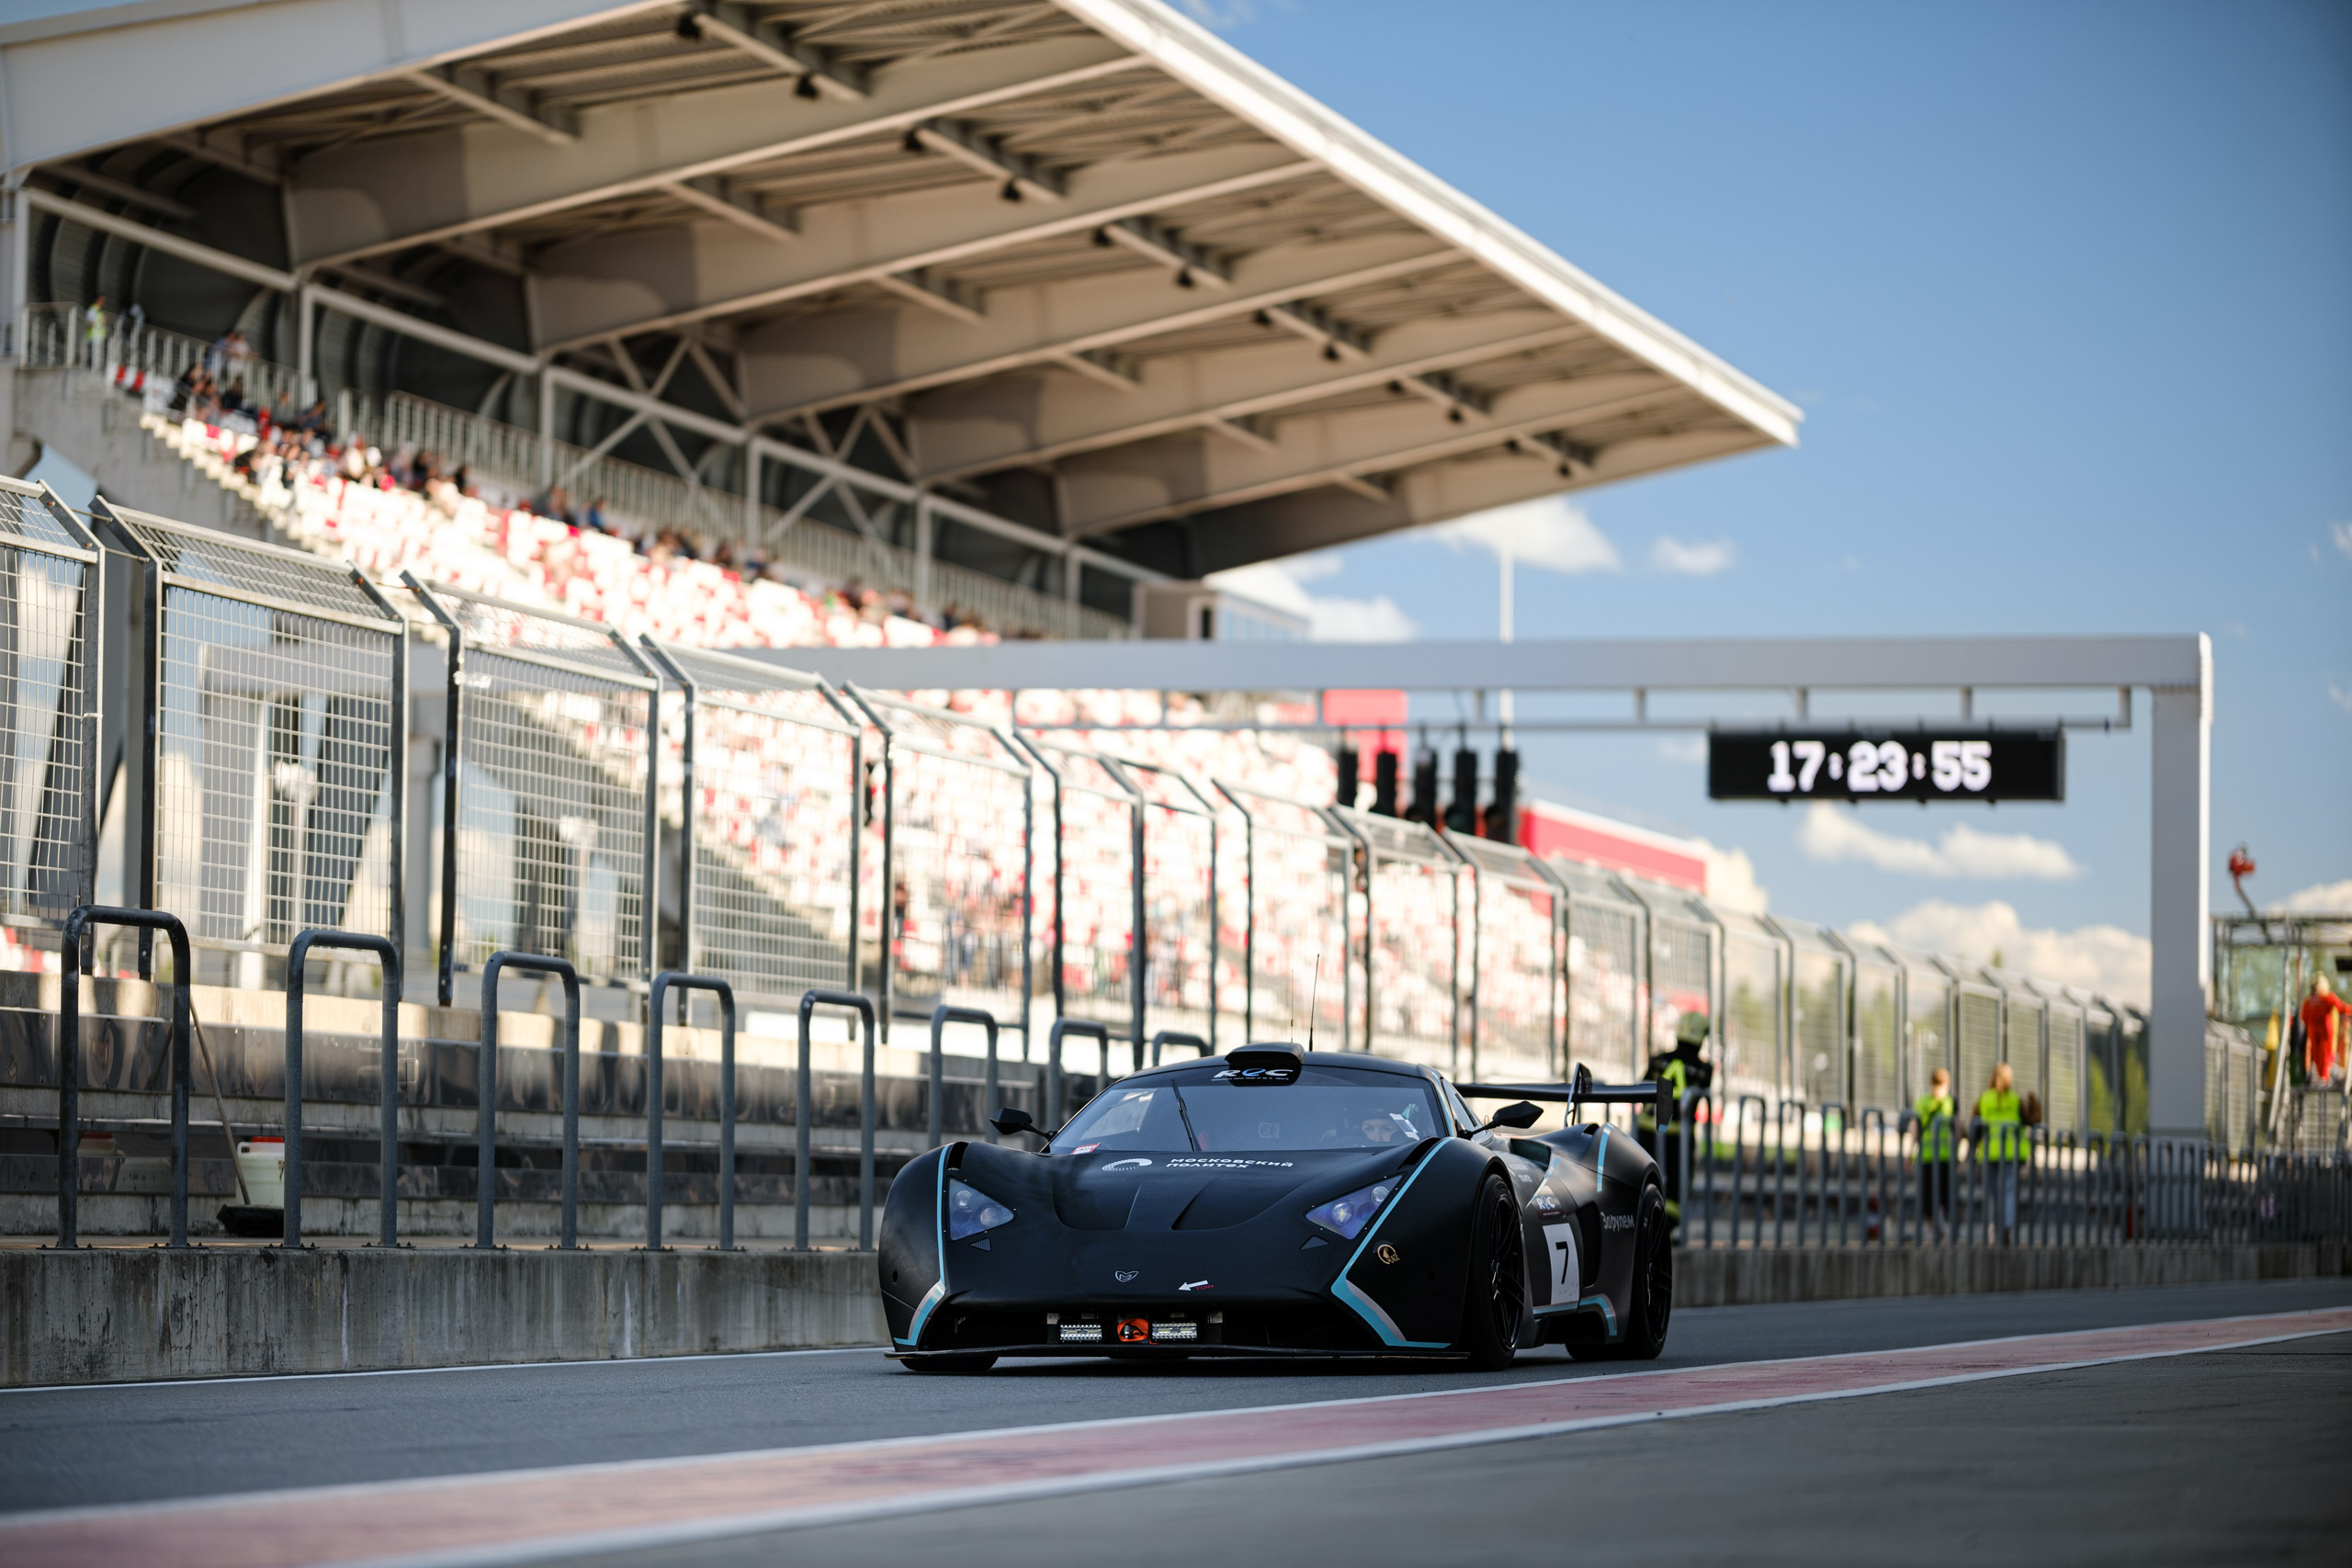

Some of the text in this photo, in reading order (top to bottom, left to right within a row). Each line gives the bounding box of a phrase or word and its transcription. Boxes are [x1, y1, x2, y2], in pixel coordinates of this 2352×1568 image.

[1768, 740, 1992, 792] 17:23:55
[1170, 1157, 1294, 1168] МОСКОВСКИЙ
[1555, 1241, 1568, 1284] 7
